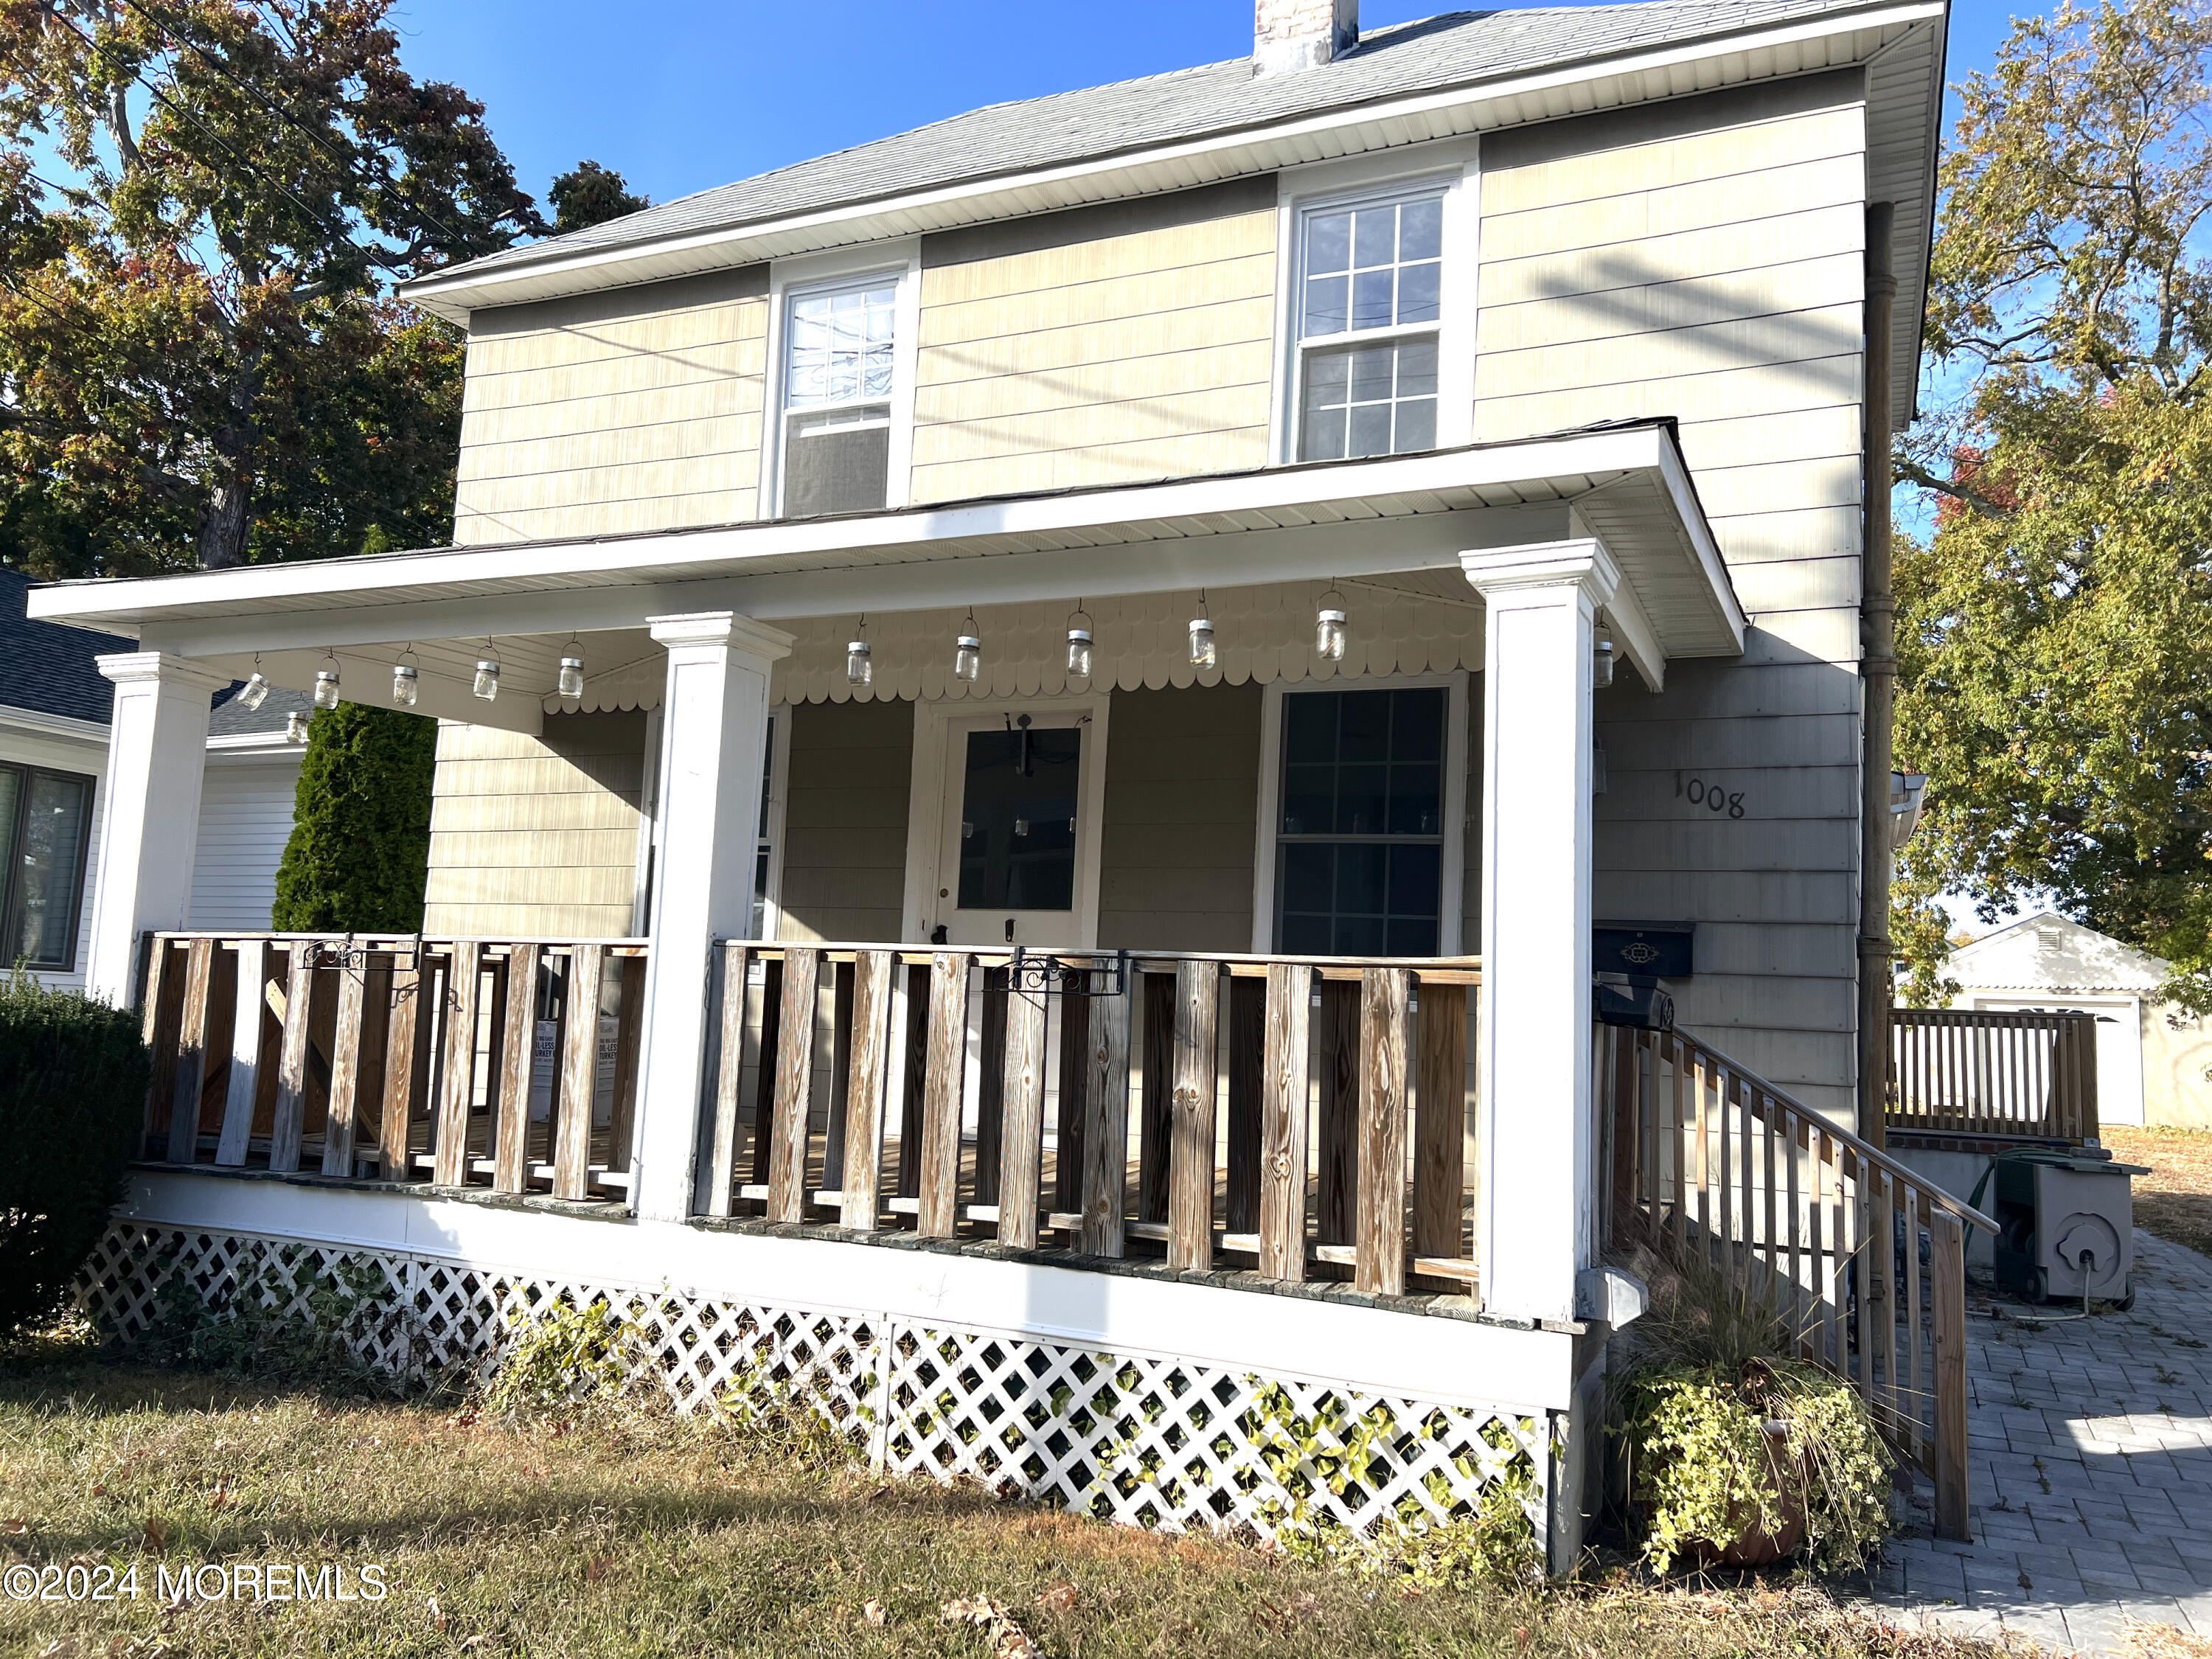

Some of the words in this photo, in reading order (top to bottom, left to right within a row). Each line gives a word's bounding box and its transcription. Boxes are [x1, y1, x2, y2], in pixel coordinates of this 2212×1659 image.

[1674, 771, 1745, 819] 1008
[599, 1043, 618, 1051] OIL-LES
[535, 1049, 552, 1057] URKEY
